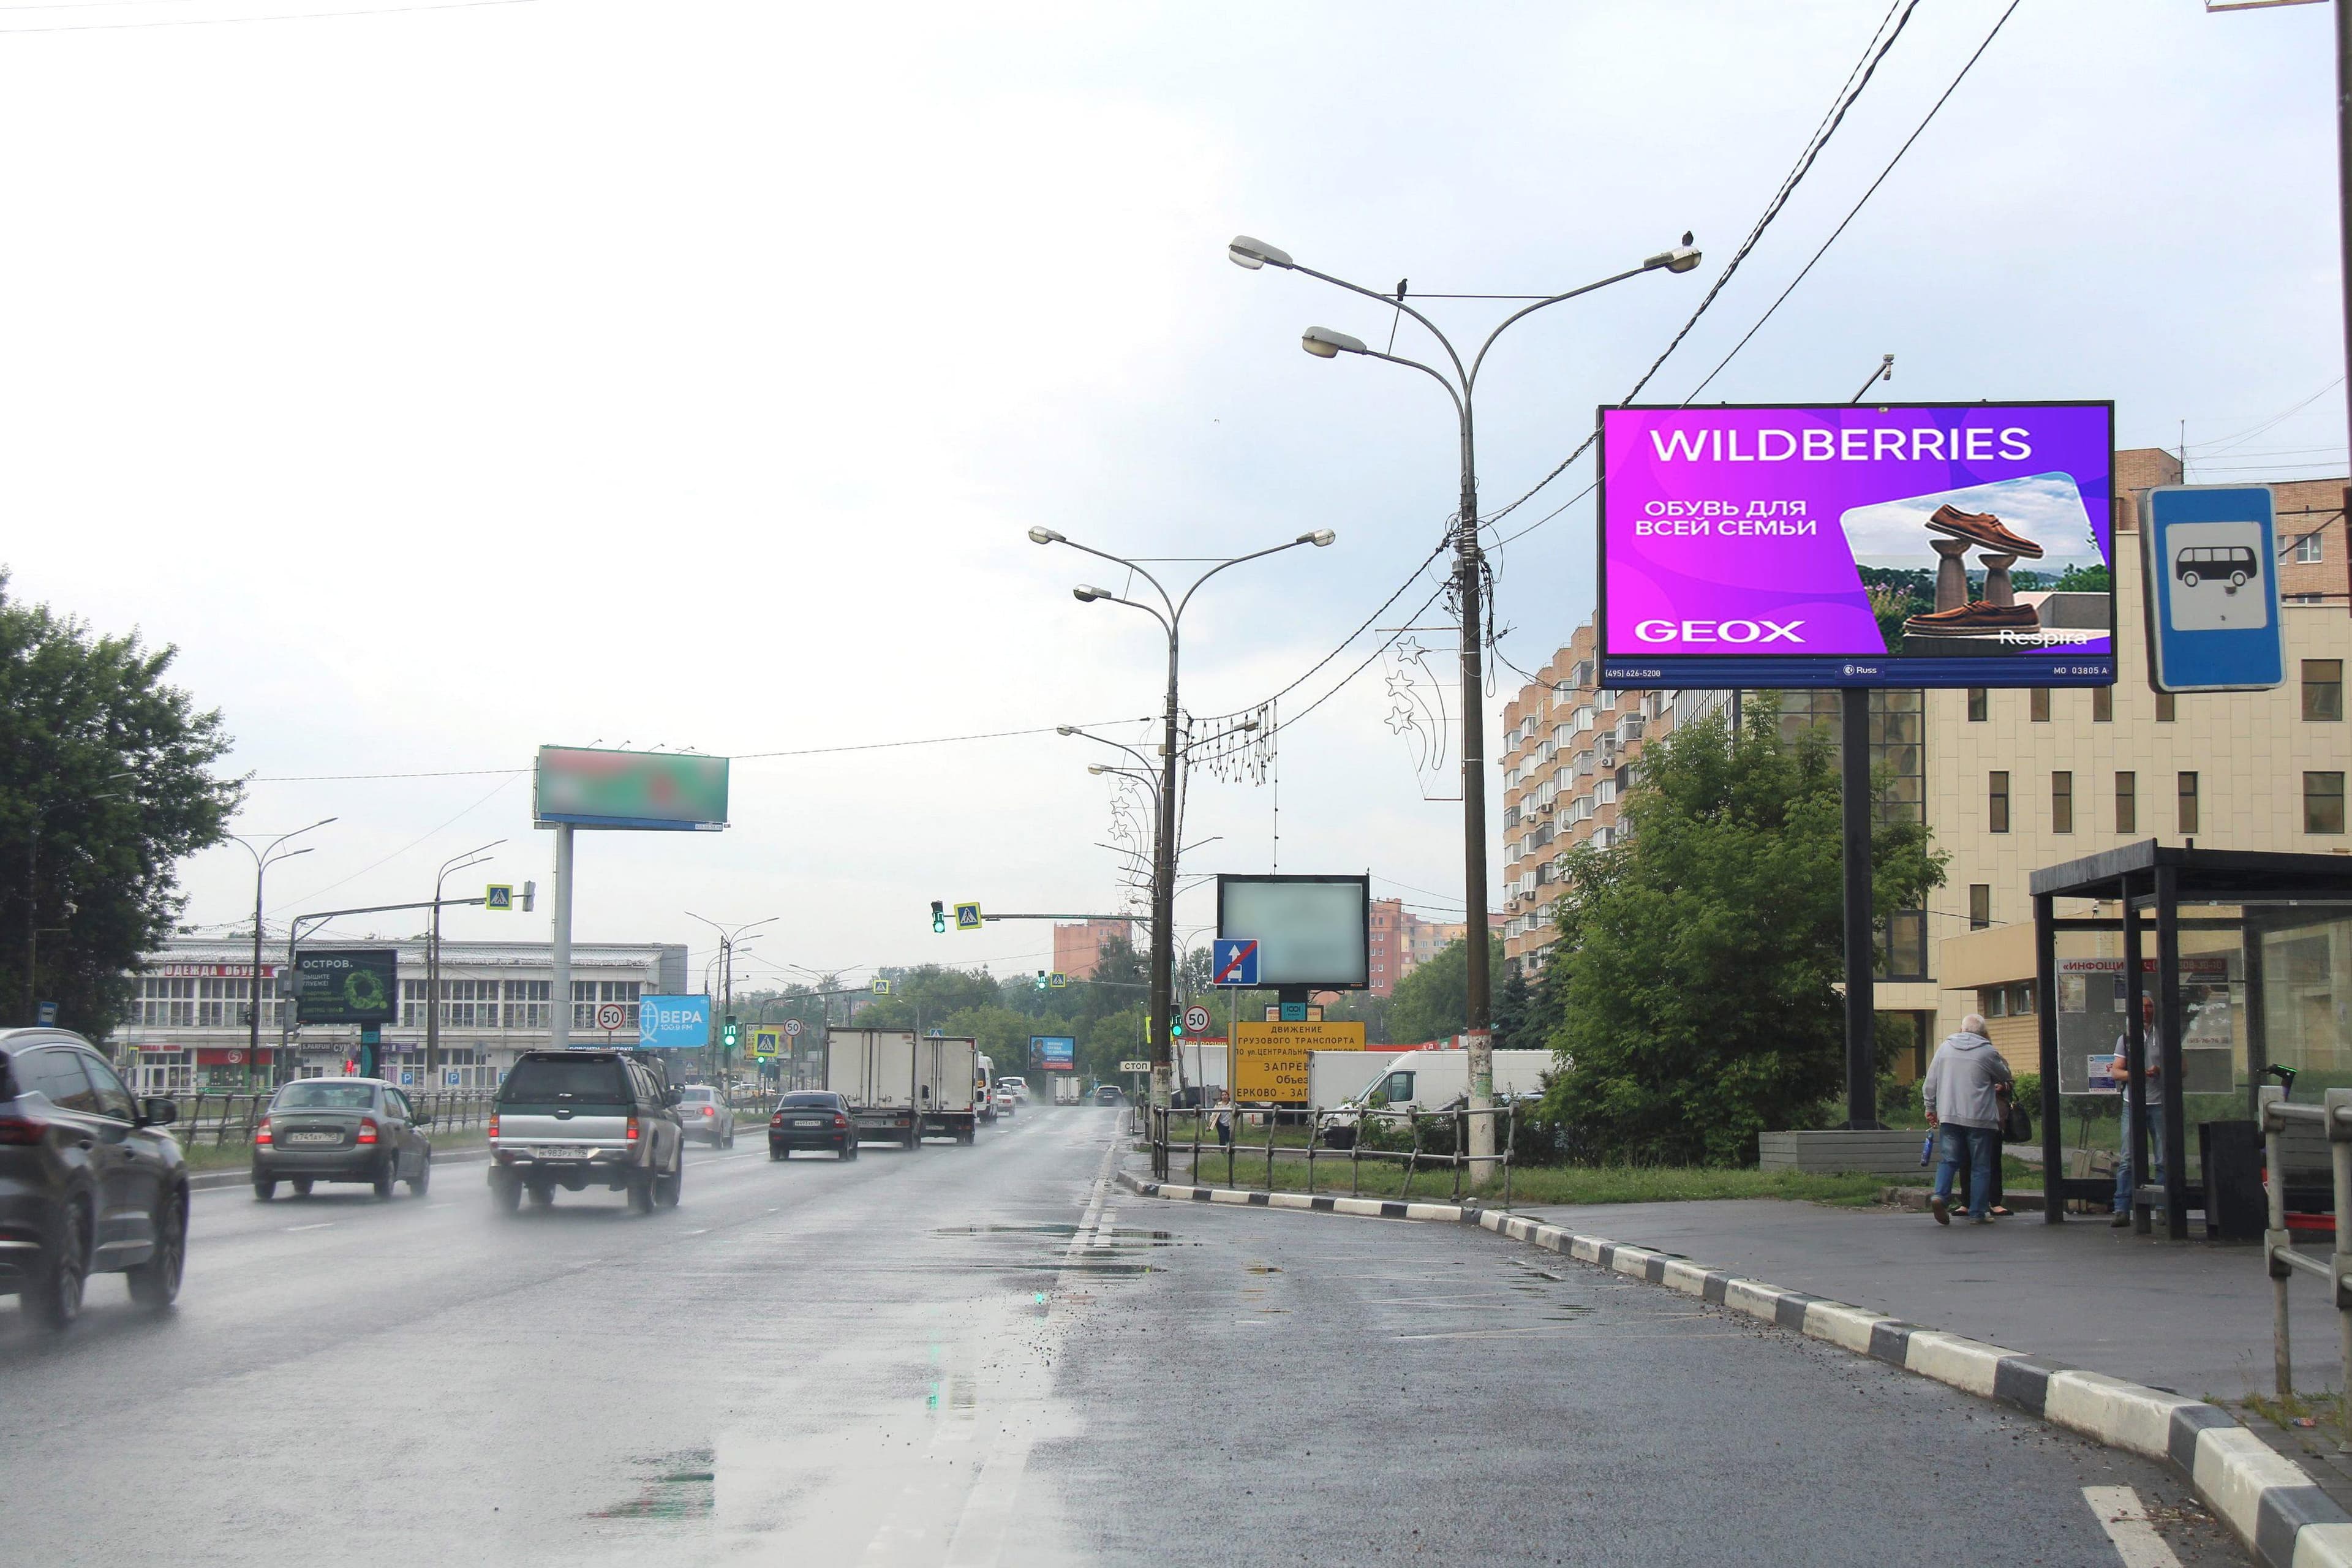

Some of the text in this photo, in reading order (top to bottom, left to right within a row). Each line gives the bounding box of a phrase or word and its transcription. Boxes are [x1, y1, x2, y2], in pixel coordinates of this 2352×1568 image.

[1649, 427, 2032, 462] WILDBERRIES
[1644, 500, 1807, 518] ОБУВЬ ДЛЯ
[1635, 516, 1817, 536] ВСЕЙ СЕМЬИ
[1634, 620, 1806, 643] GEOX
[2000, 630, 2088, 647] Respira
[1605, 669, 1624, 677] (495)
[1856, 665, 1877, 674] Russ
[303, 960, 353, 968] ОСТРОВ.
[2063, 962, 2124, 971] «ИНФОЩИ
[166, 965, 217, 977] ОДЕЖДА
[603, 1011, 620, 1023] 50
[661, 1011, 703, 1023] ВЕРА
[1189, 1014, 1205, 1026] 50
[787, 1023, 799, 1031] 50
[1236, 1088, 1276, 1097] ЕРКОВО
